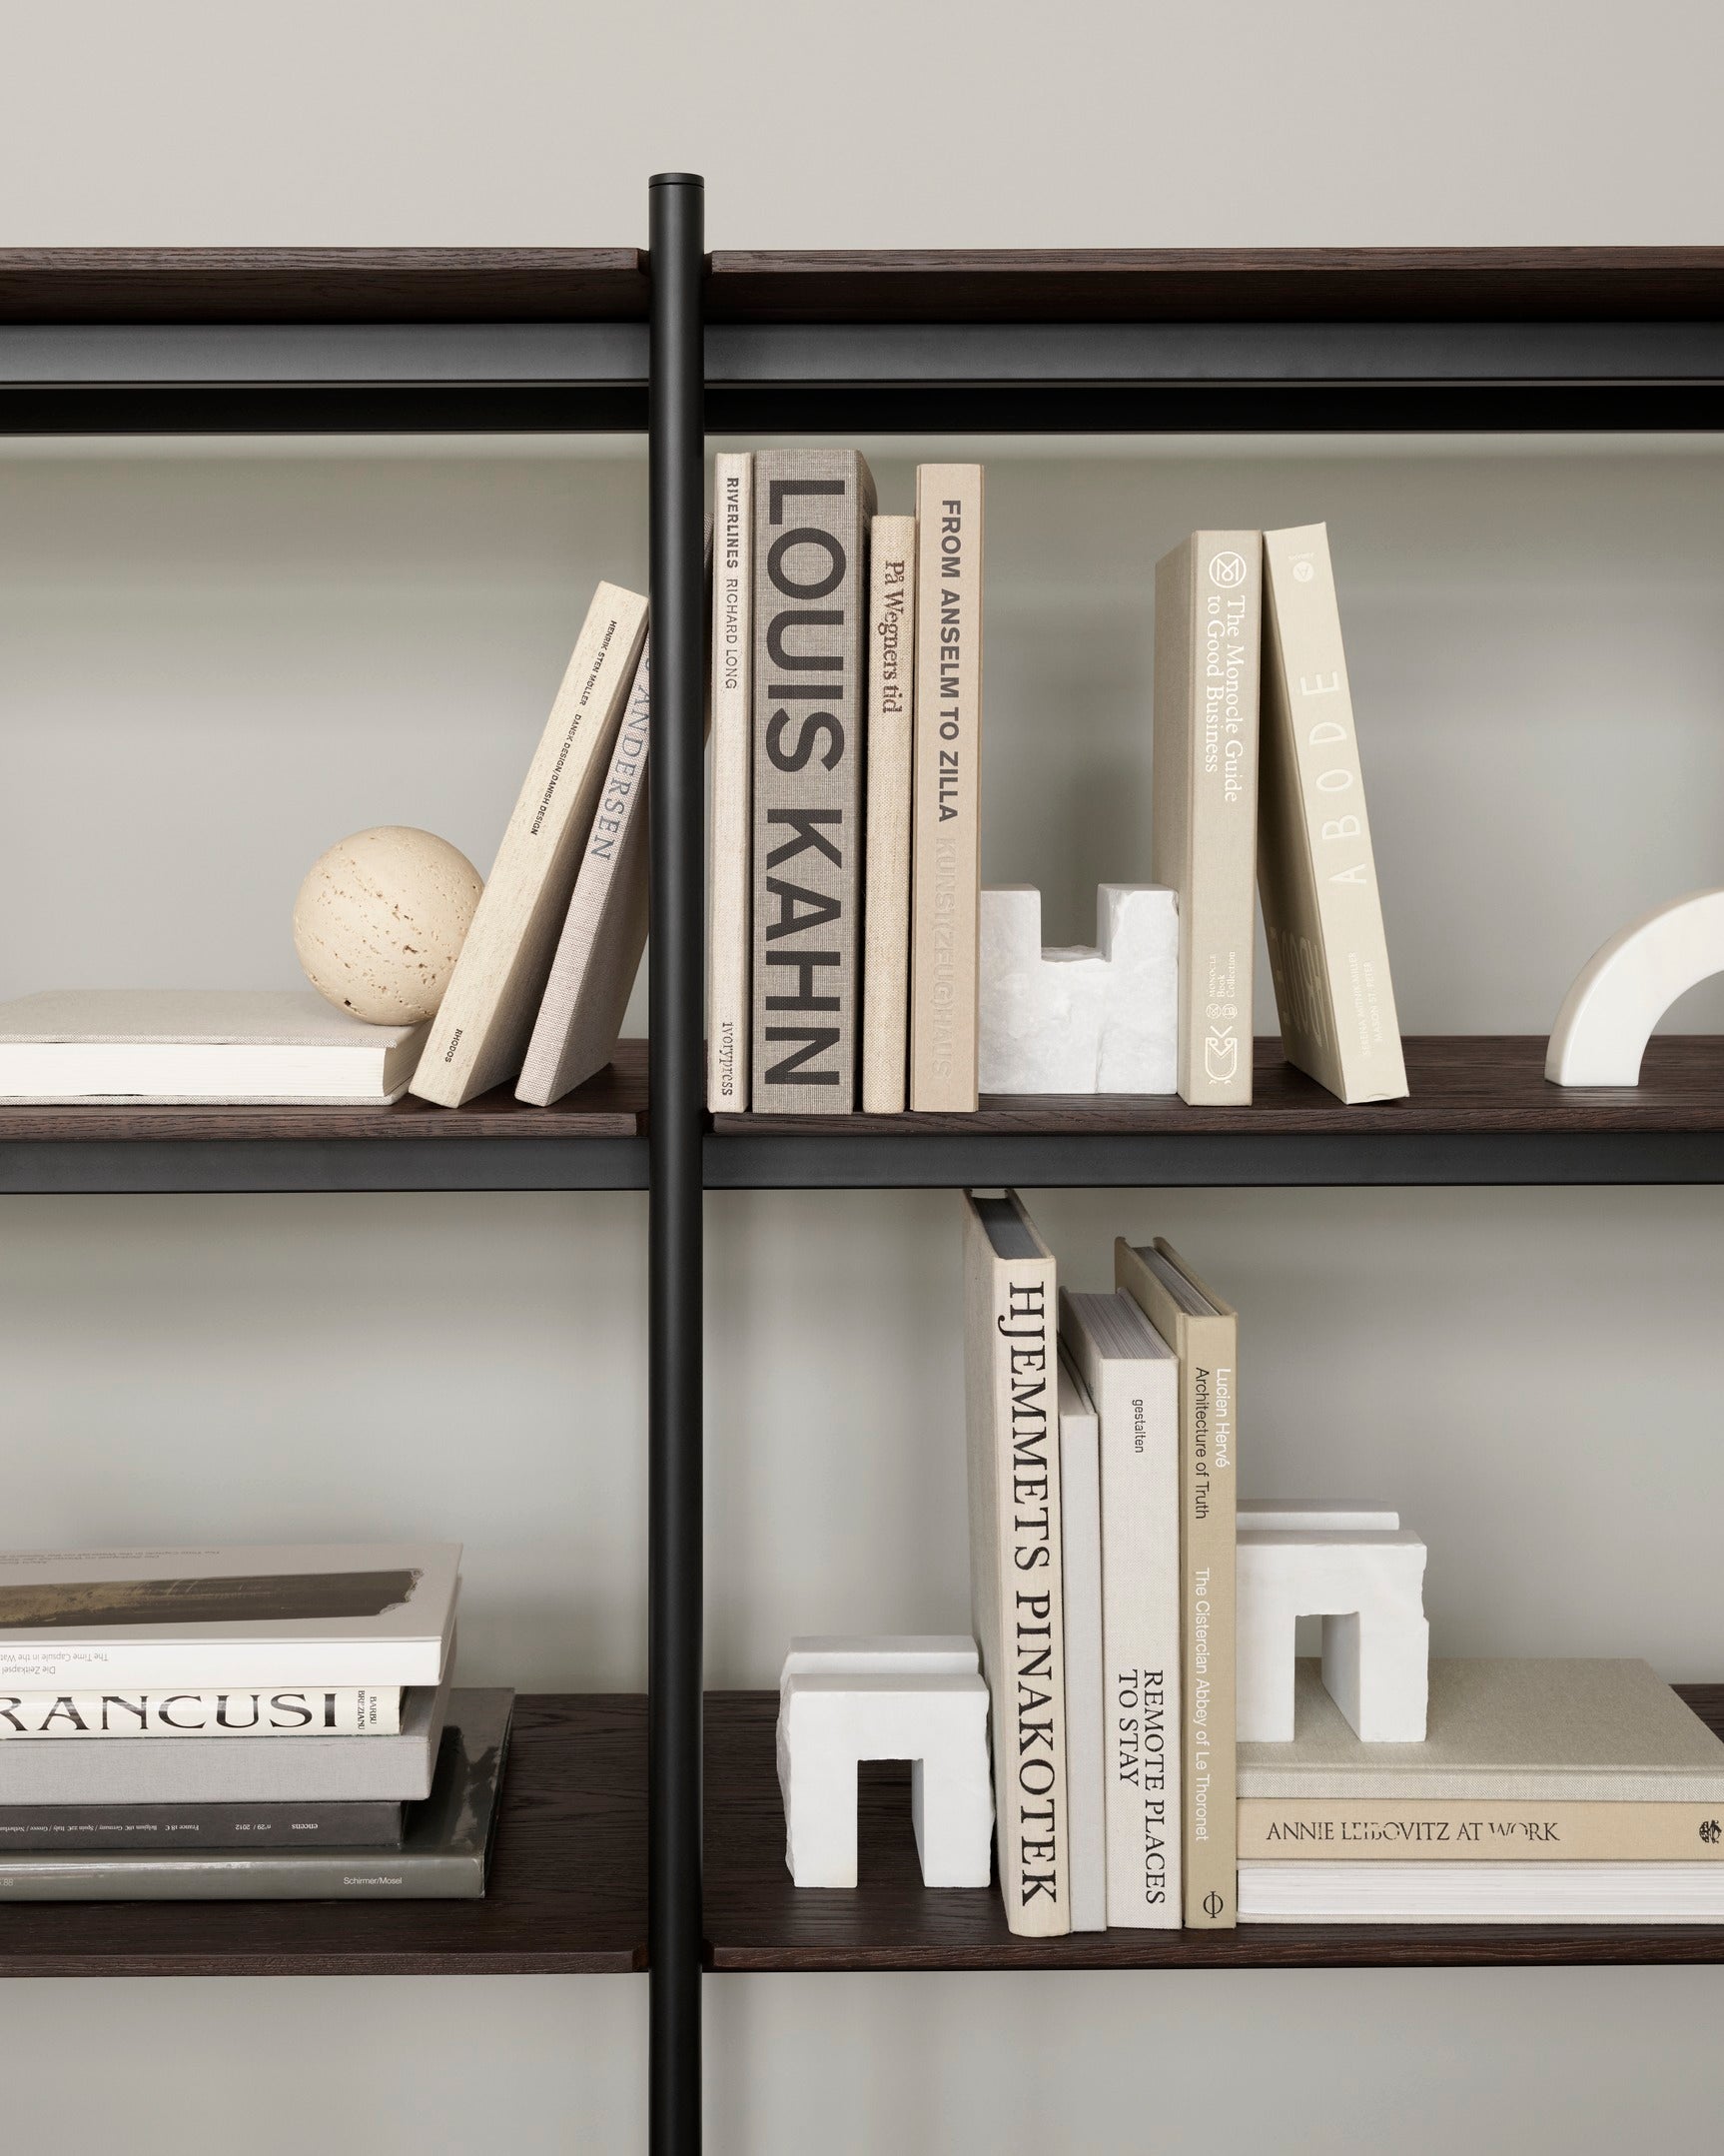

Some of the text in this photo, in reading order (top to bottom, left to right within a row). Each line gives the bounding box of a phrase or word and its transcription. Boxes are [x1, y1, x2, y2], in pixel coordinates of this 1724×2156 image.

[725, 478, 739, 688] RIVERLINES RICHARD LONG
[592, 652, 605, 674] STEN
[601, 620, 617, 650] HENRIK
[878, 560, 904, 713] På Wegners tid
[939, 501, 961, 822] FROM ANSELM TO ZILLA
[1205, 595, 1225, 772] to Good Business
[1225, 595, 1245, 801] The Monocle Guide
[565, 713, 581, 741] DANSK
[765, 480, 846, 1085] LOUIS KAHN
[530, 807, 546, 835] DESIGN
[1227, 952, 1236, 998] Collection
[444, 1028, 462, 1063] RHODOS
[719, 1022, 733, 1095] ivorypress
[1132, 1400, 1146, 1453] gestalten
[1216, 1369, 1231, 1468] Lucien Hervé
[998, 1282, 1056, 1906] HJEMMETS PINAKOTEK
[1193, 1368, 1210, 1840] Architecture of Truth The Cistercian Abbey of Le Thoronet
[2, 1665, 56, 1675] Die Zeitkapsel
[41, 1652, 71, 1662] Capsule
[1119, 1669, 1139, 1786] TO STAY
[1145, 1670, 1165, 1903] REMOTE PLACES
[1267, 1822, 1333, 1839] ANNIE
[1457, 1822, 1483, 1840] AT
[344, 1876, 402, 1886] Schirmer/Mosel
